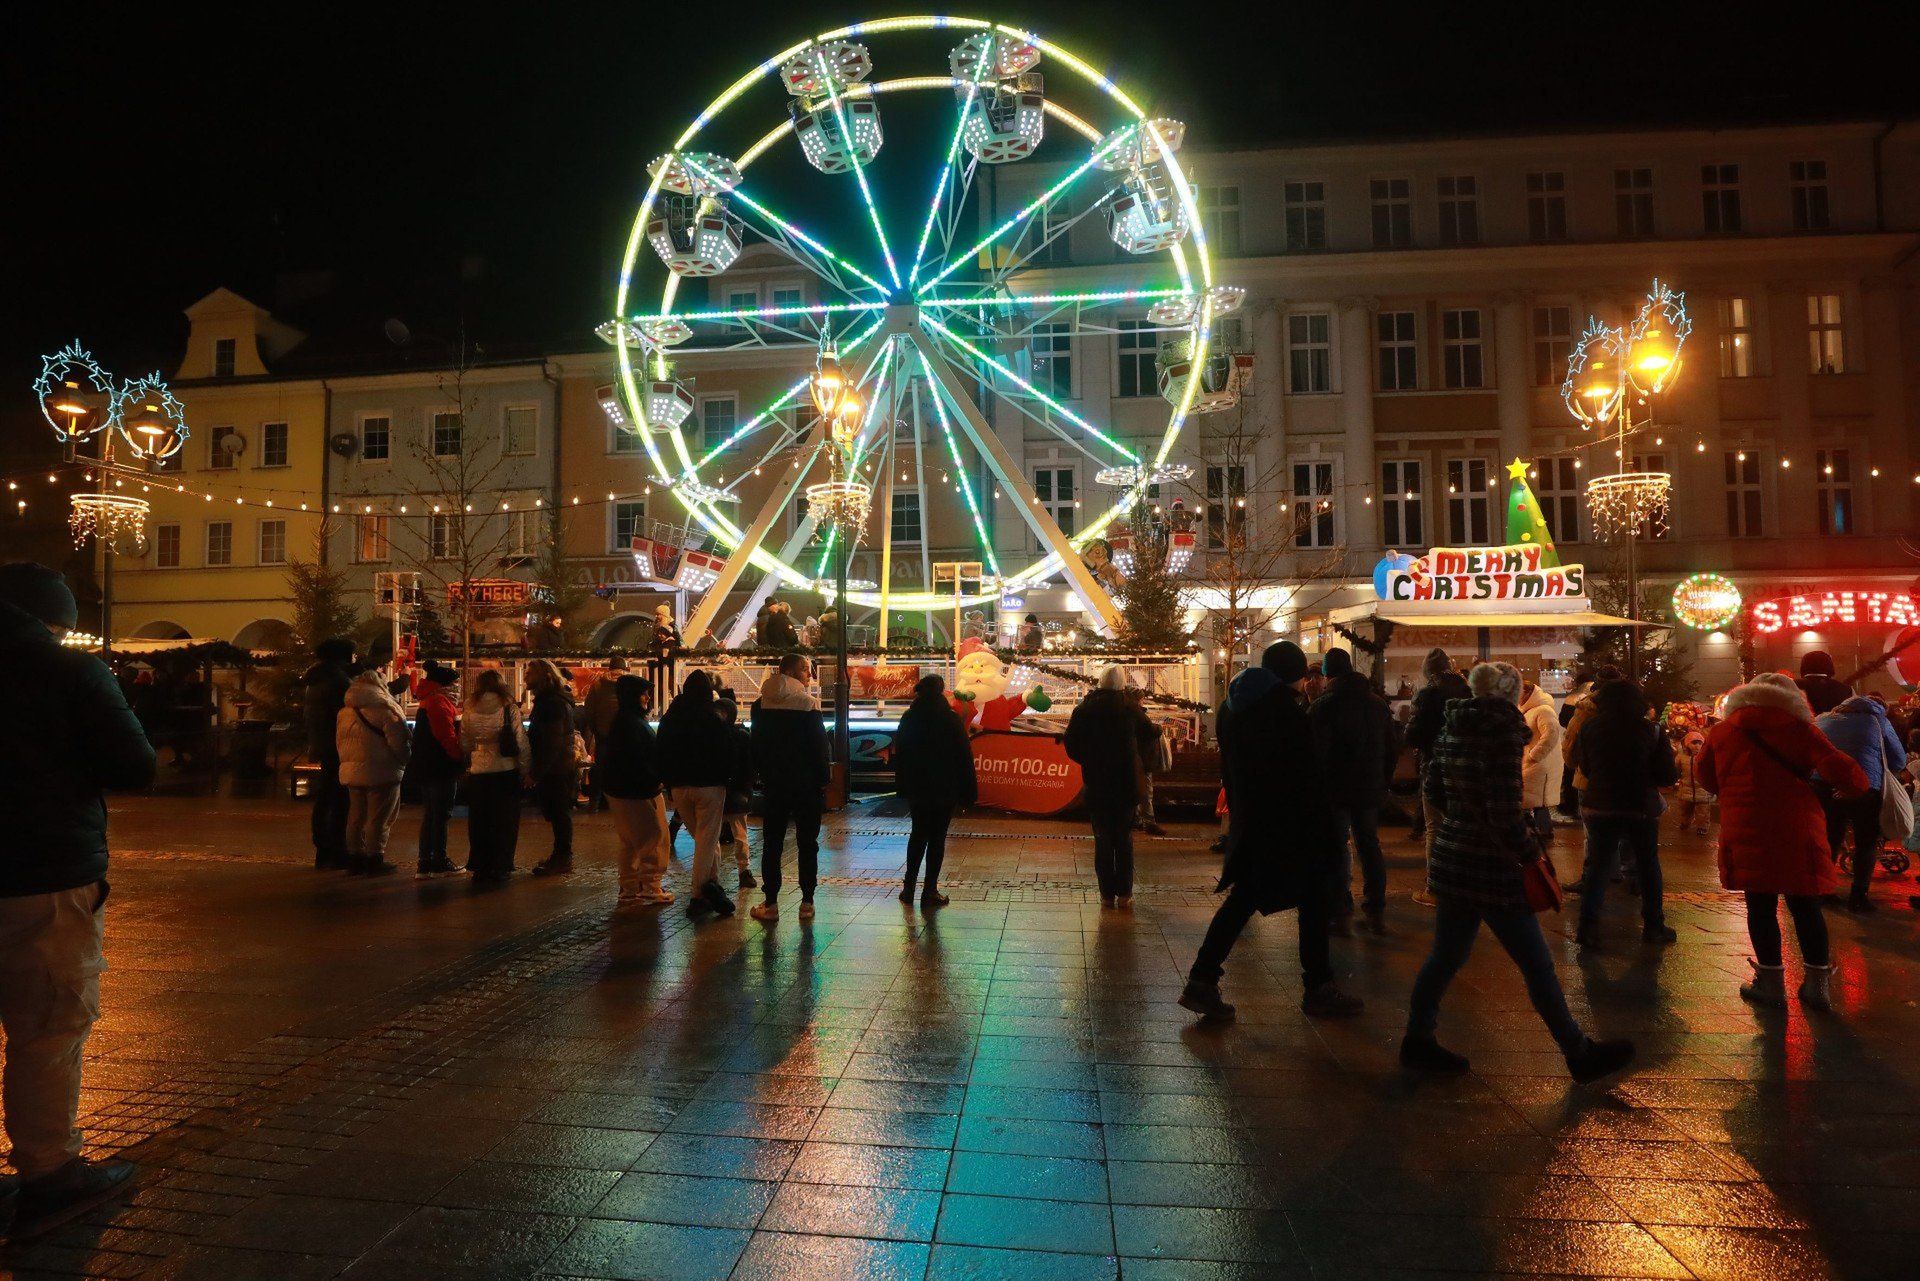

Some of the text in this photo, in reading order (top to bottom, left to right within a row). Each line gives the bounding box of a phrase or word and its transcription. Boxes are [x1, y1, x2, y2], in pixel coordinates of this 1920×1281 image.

[1436, 546, 1541, 575] MERRY
[451, 586, 522, 601] BY HERE
[1393, 568, 1584, 600] CHRISTMAS
[1753, 592, 1920, 633] SANTA
[974, 754, 1070, 777] dom100.eu
